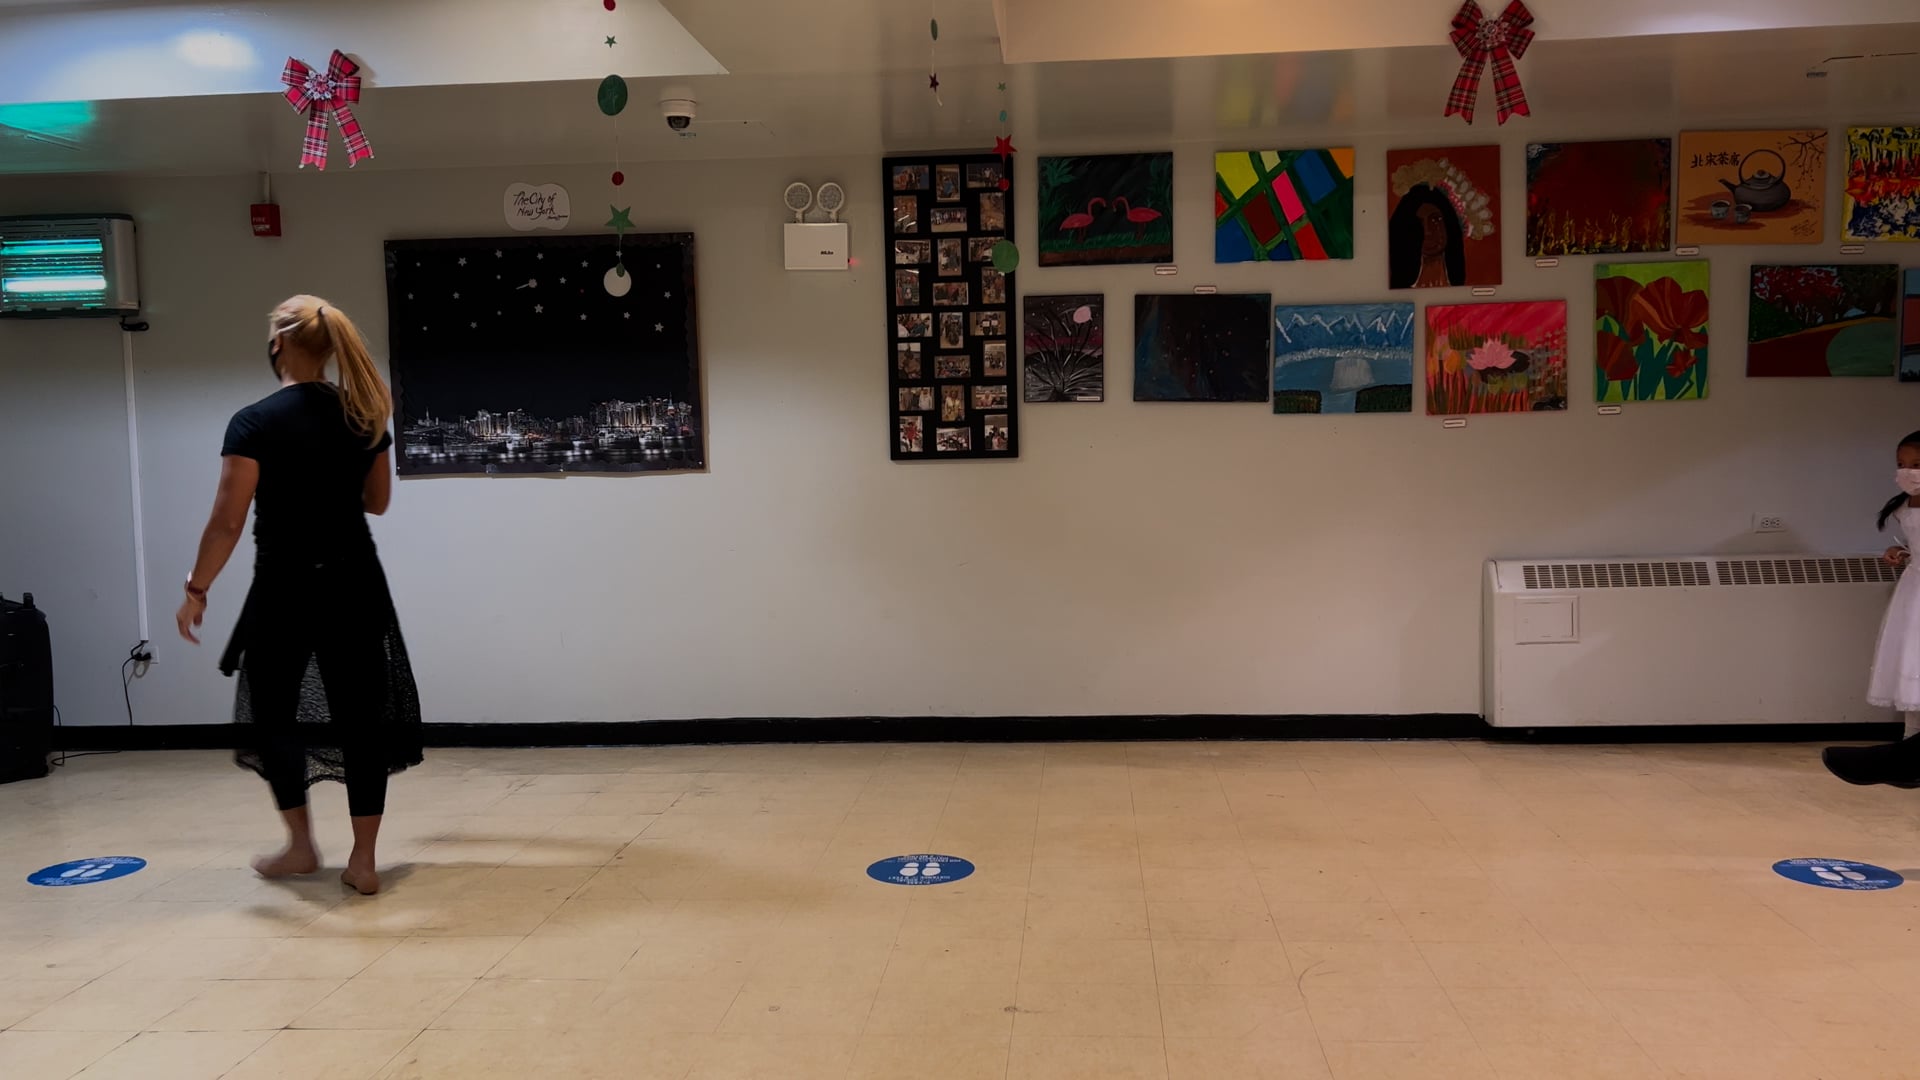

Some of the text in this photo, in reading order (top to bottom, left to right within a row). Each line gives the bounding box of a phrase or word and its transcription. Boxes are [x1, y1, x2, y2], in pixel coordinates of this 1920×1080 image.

[513, 191, 557, 211] The City of
[517, 206, 533, 216] New
[530, 207, 556, 220] York
